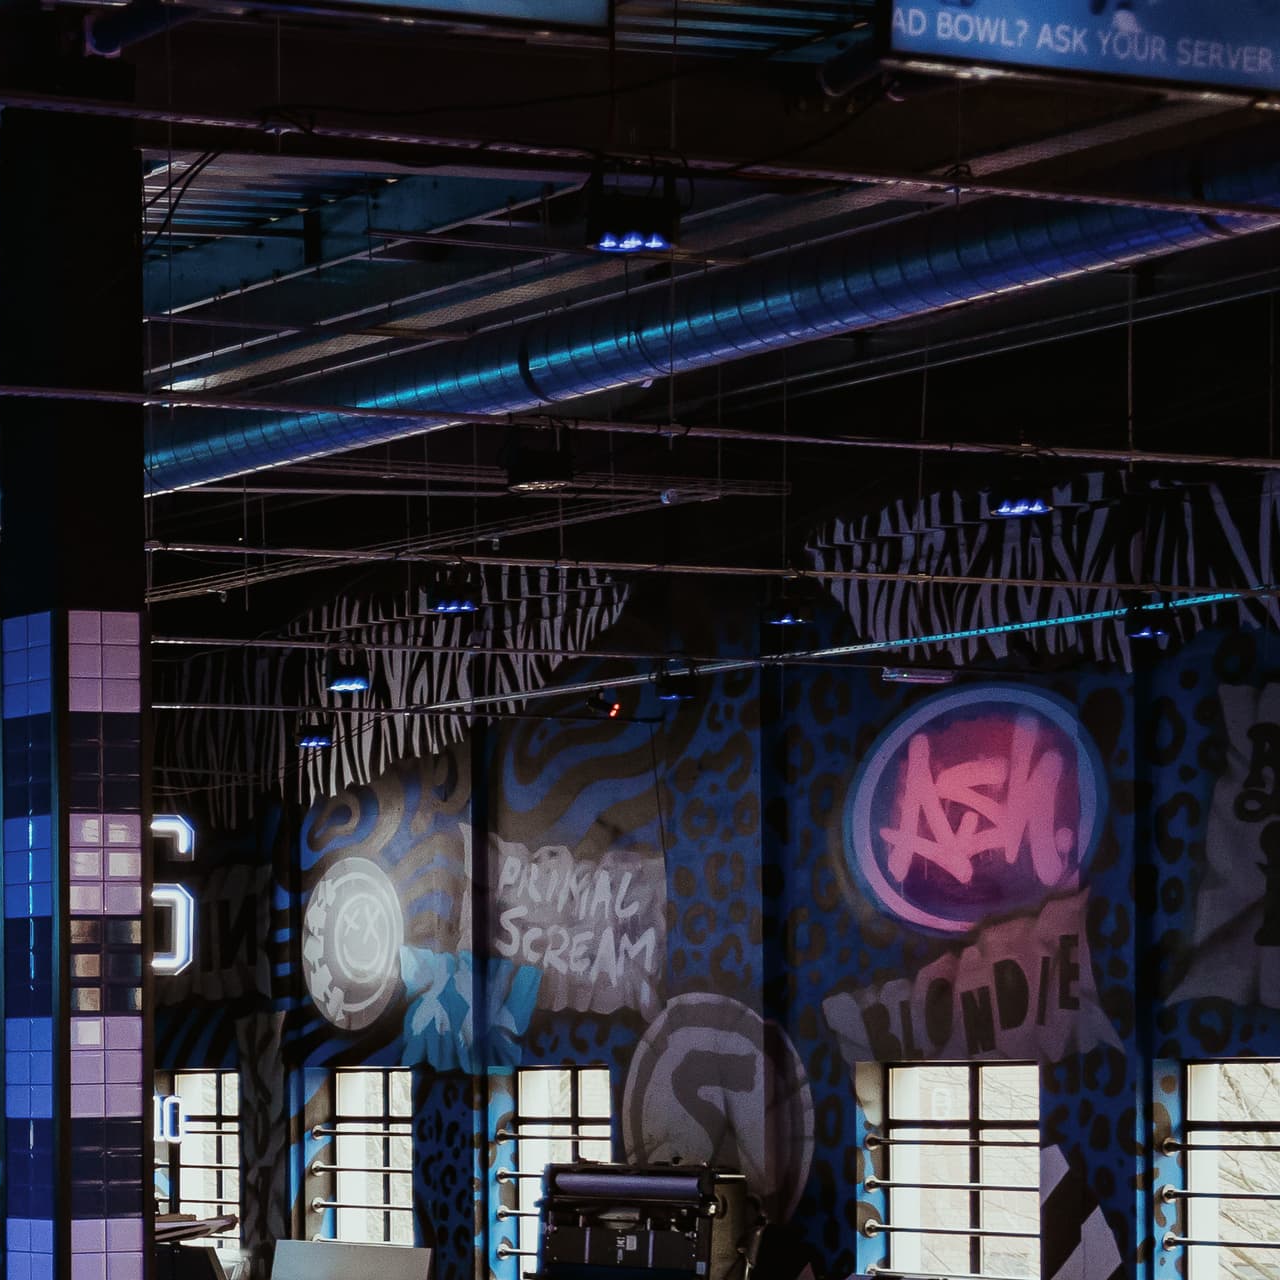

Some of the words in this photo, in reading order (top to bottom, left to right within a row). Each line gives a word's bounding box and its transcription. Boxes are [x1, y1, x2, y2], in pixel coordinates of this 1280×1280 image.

[936, 12, 1030, 49] BOWL?
[1037, 24, 1089, 55] ASK
[1097, 30, 1168, 63] YOUR
[1177, 38, 1275, 74] SERVER
[497, 855, 641, 921] PRIMAL
[495, 904, 656, 988] SCREAM
[861, 934, 1081, 1062] BLONDIE
